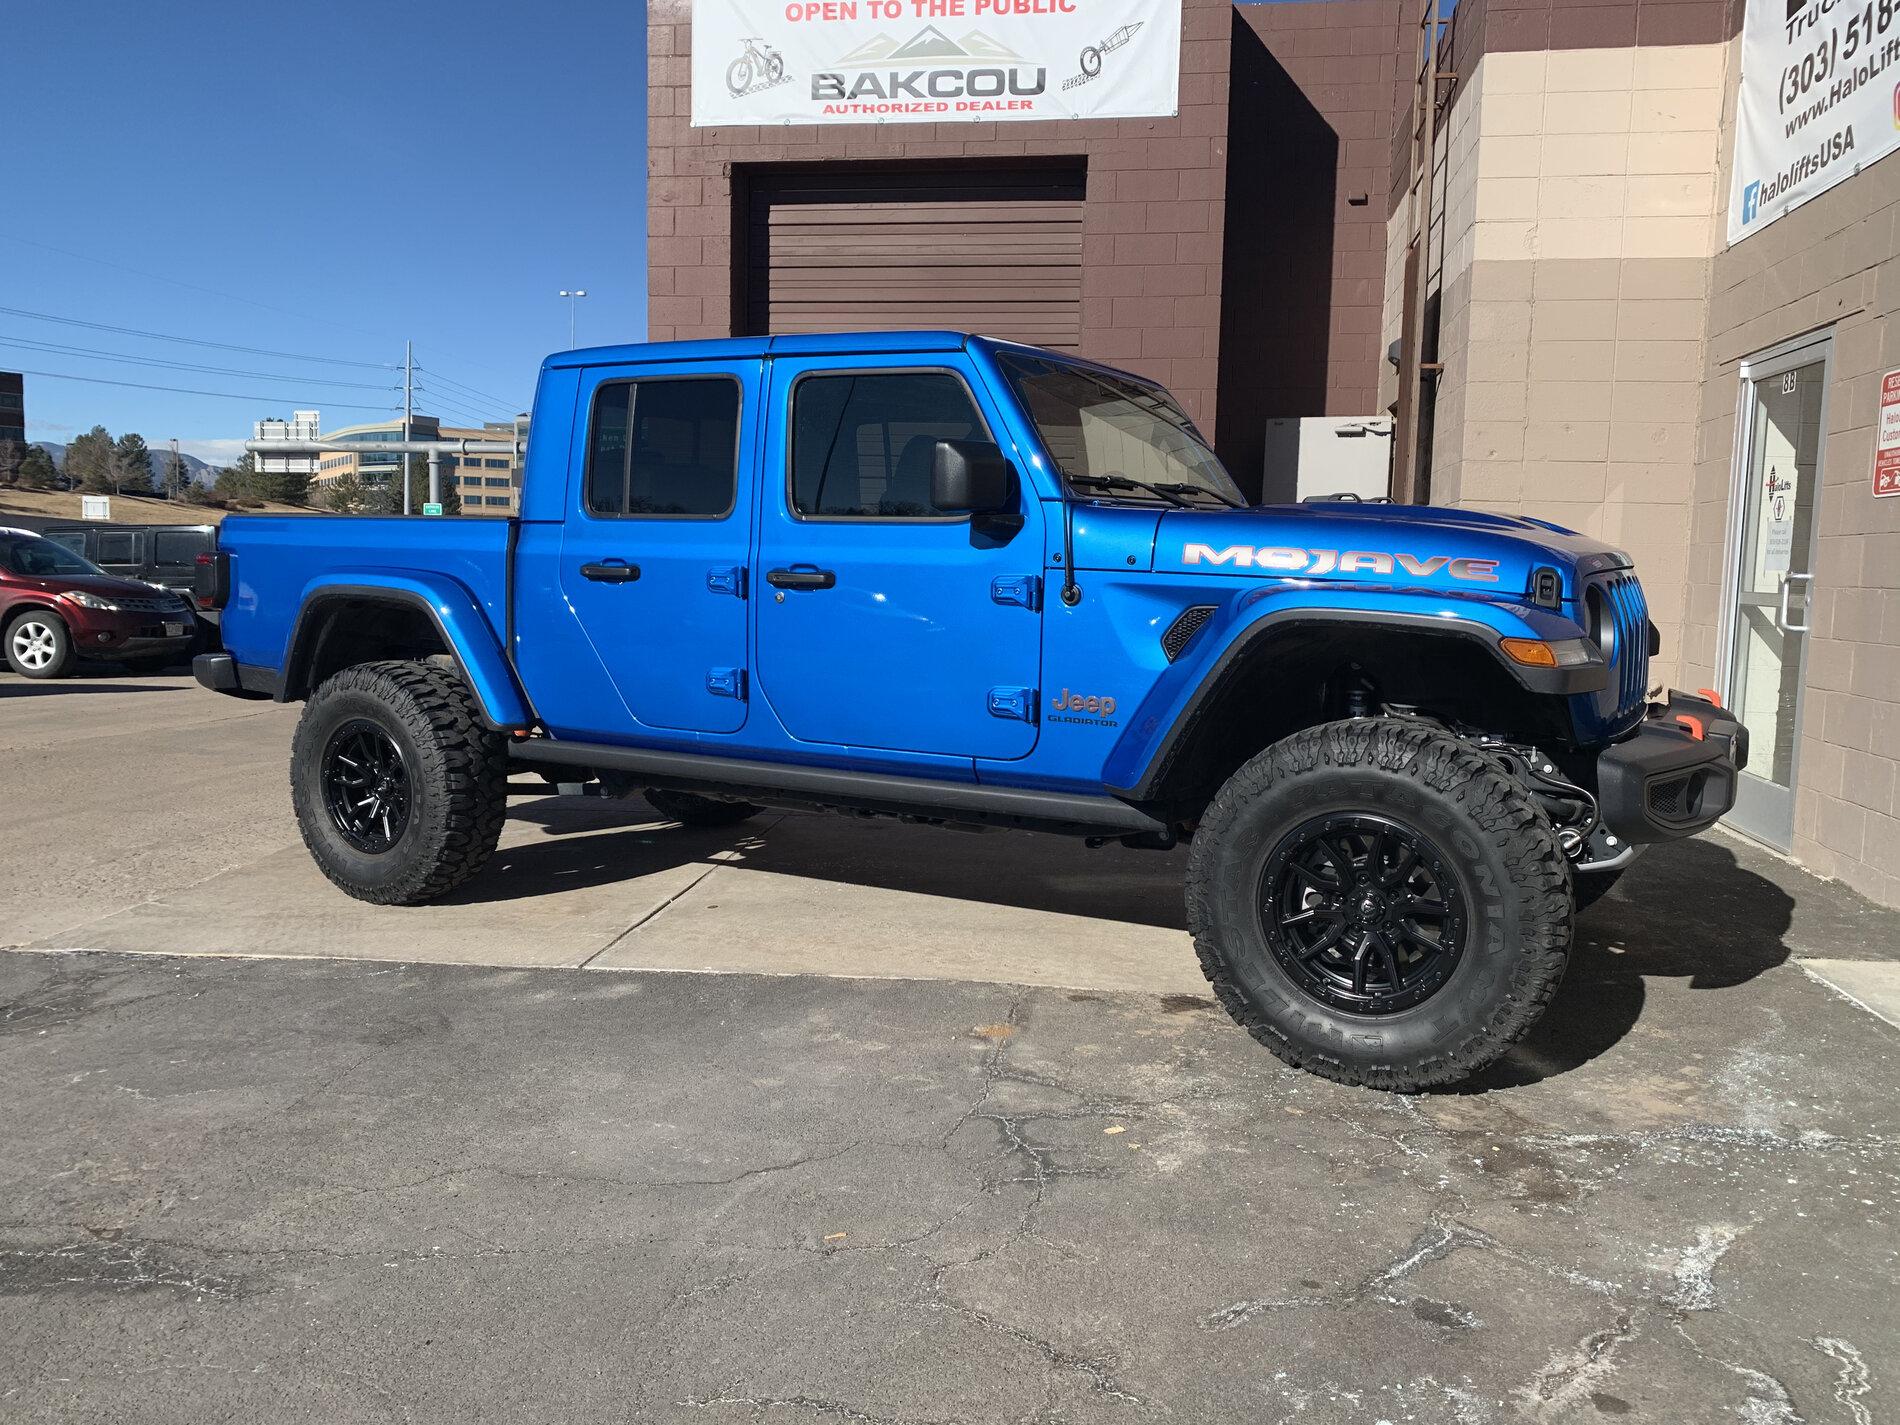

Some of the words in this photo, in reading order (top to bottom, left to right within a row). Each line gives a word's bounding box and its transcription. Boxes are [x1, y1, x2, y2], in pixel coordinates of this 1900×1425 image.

[785, 2, 857, 22] OPEN
[866, 0, 903, 19] TO
[911, 0, 965, 17] THE
[974, 0, 1077, 16] PUBLIC
[1786, 0, 1841, 45] Truc
[811, 67, 1046, 100] BAKCOU
[1779, 27, 1838, 114] (303)
[822, 102, 949, 115] AUTHORIZED
[955, 100, 1034, 112] DEALER
[1759, 124, 1855, 206] haloliftsUSA
[1783, 372, 1796, 392] 8B
[1182, 542, 1500, 581] MOJAVE
[1052, 687, 1116, 718] Jeep
[1048, 715, 1119, 727] GLADIATOR
